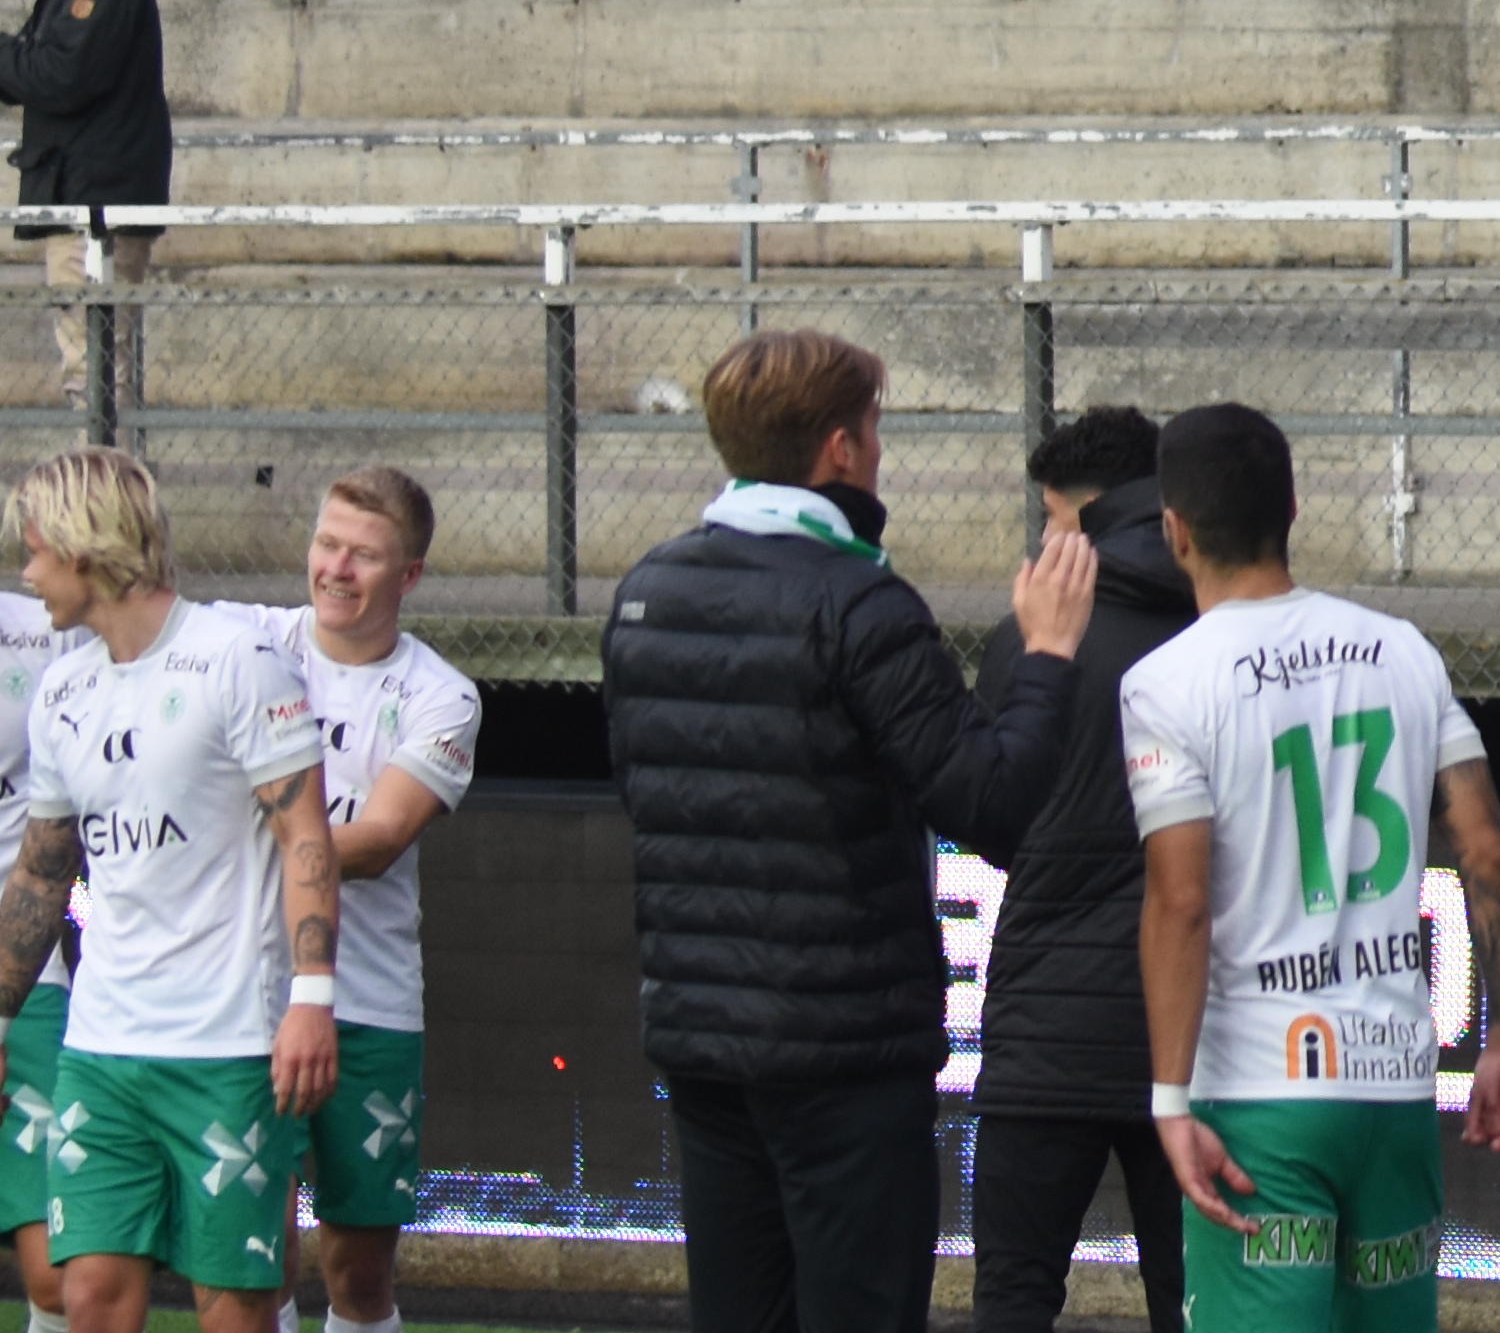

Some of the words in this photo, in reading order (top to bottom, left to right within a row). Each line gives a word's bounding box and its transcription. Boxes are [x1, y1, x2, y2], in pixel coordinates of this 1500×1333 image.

[1233, 635, 1385, 699] Kjelstad
[1272, 705, 1411, 916] 13
[1338, 1009, 1420, 1048] Utafor
